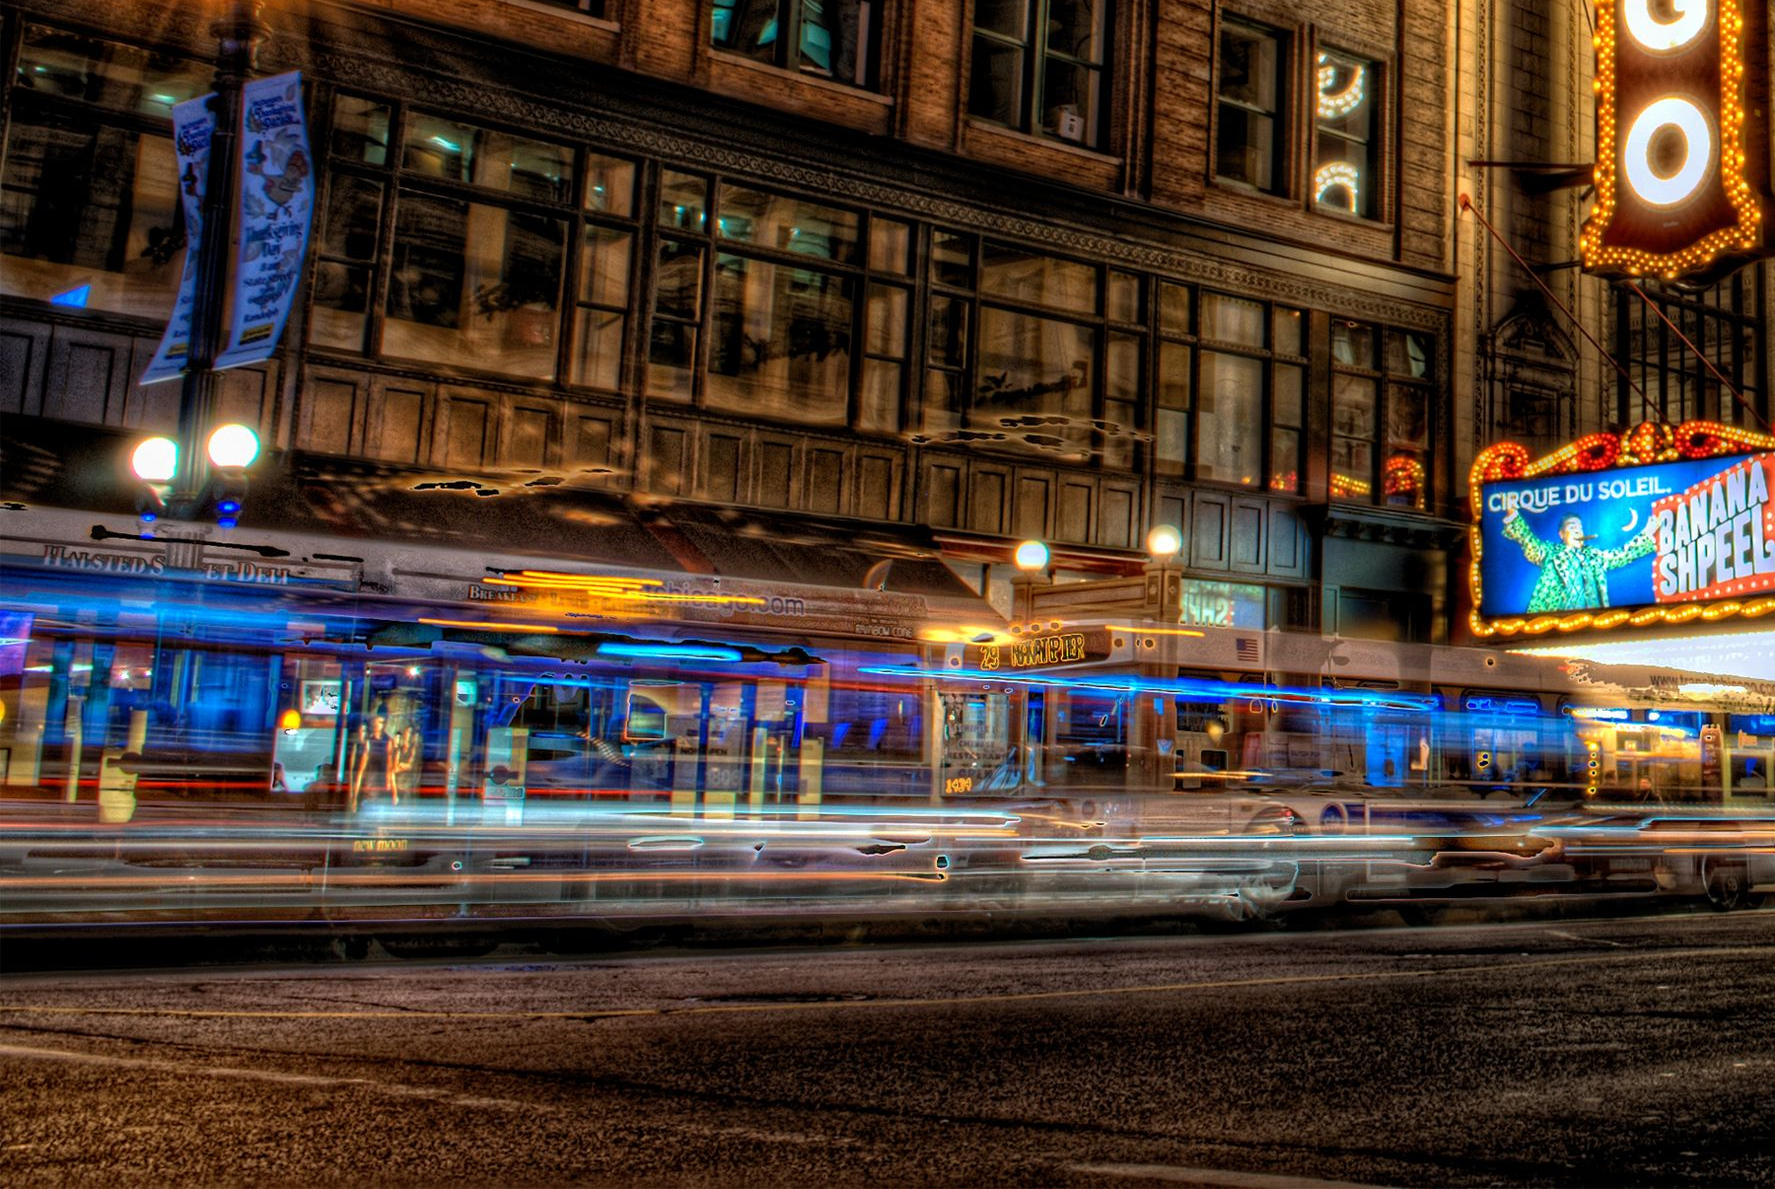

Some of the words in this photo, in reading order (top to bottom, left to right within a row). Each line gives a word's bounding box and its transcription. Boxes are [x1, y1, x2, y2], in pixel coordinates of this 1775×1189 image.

[1488, 485, 1564, 513] CIRQUE
[1565, 482, 1594, 504] DU
[1659, 461, 1769, 556] BANANA
